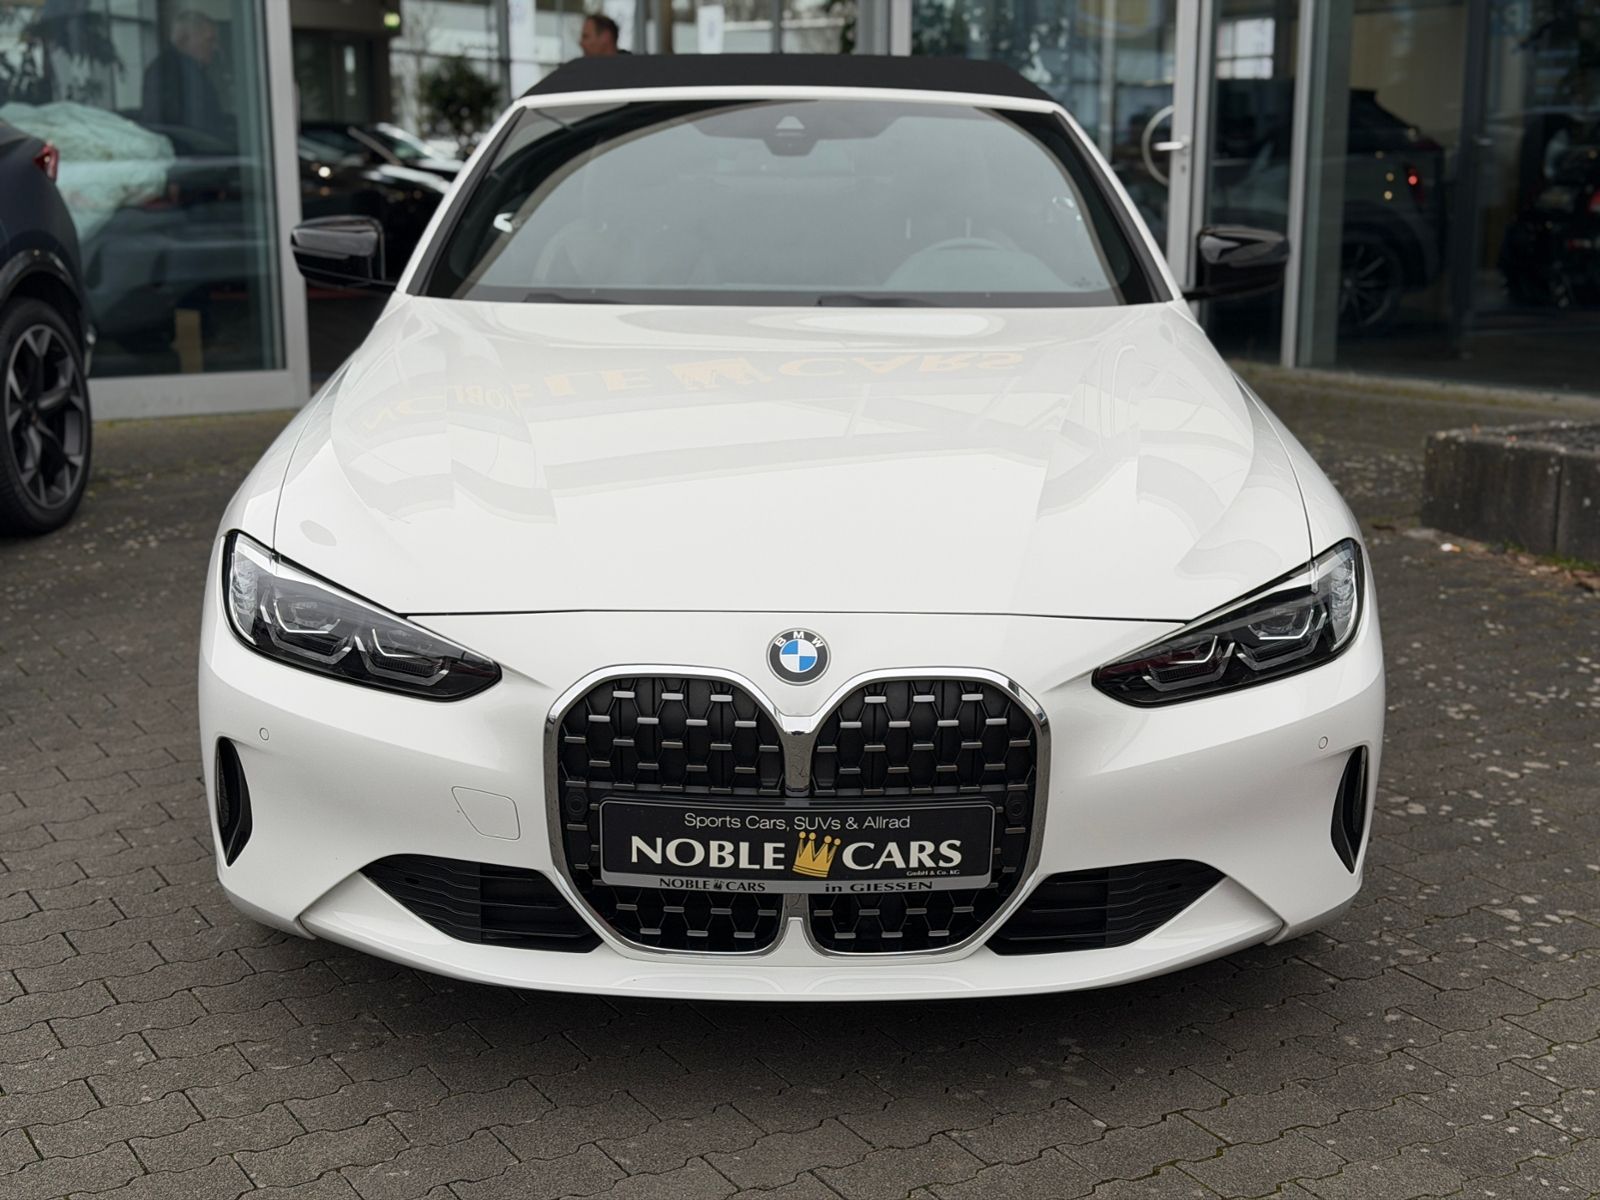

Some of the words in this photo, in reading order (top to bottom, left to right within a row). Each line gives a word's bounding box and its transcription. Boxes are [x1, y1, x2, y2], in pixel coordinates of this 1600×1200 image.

[775, 631, 825, 648] BMW
[684, 812, 741, 829] Sports
[745, 815, 790, 831] Cars,
[793, 816, 841, 830] SUVs
[845, 816, 859, 830] &
[862, 815, 911, 829] Allrad
[631, 835, 786, 870] NOBLE
[842, 839, 962, 871] CARS
[659, 877, 711, 890] NOBLE
[725, 881, 766, 892] CARS
[825, 883, 842, 893] in
[850, 881, 933, 893] GIESSEN
